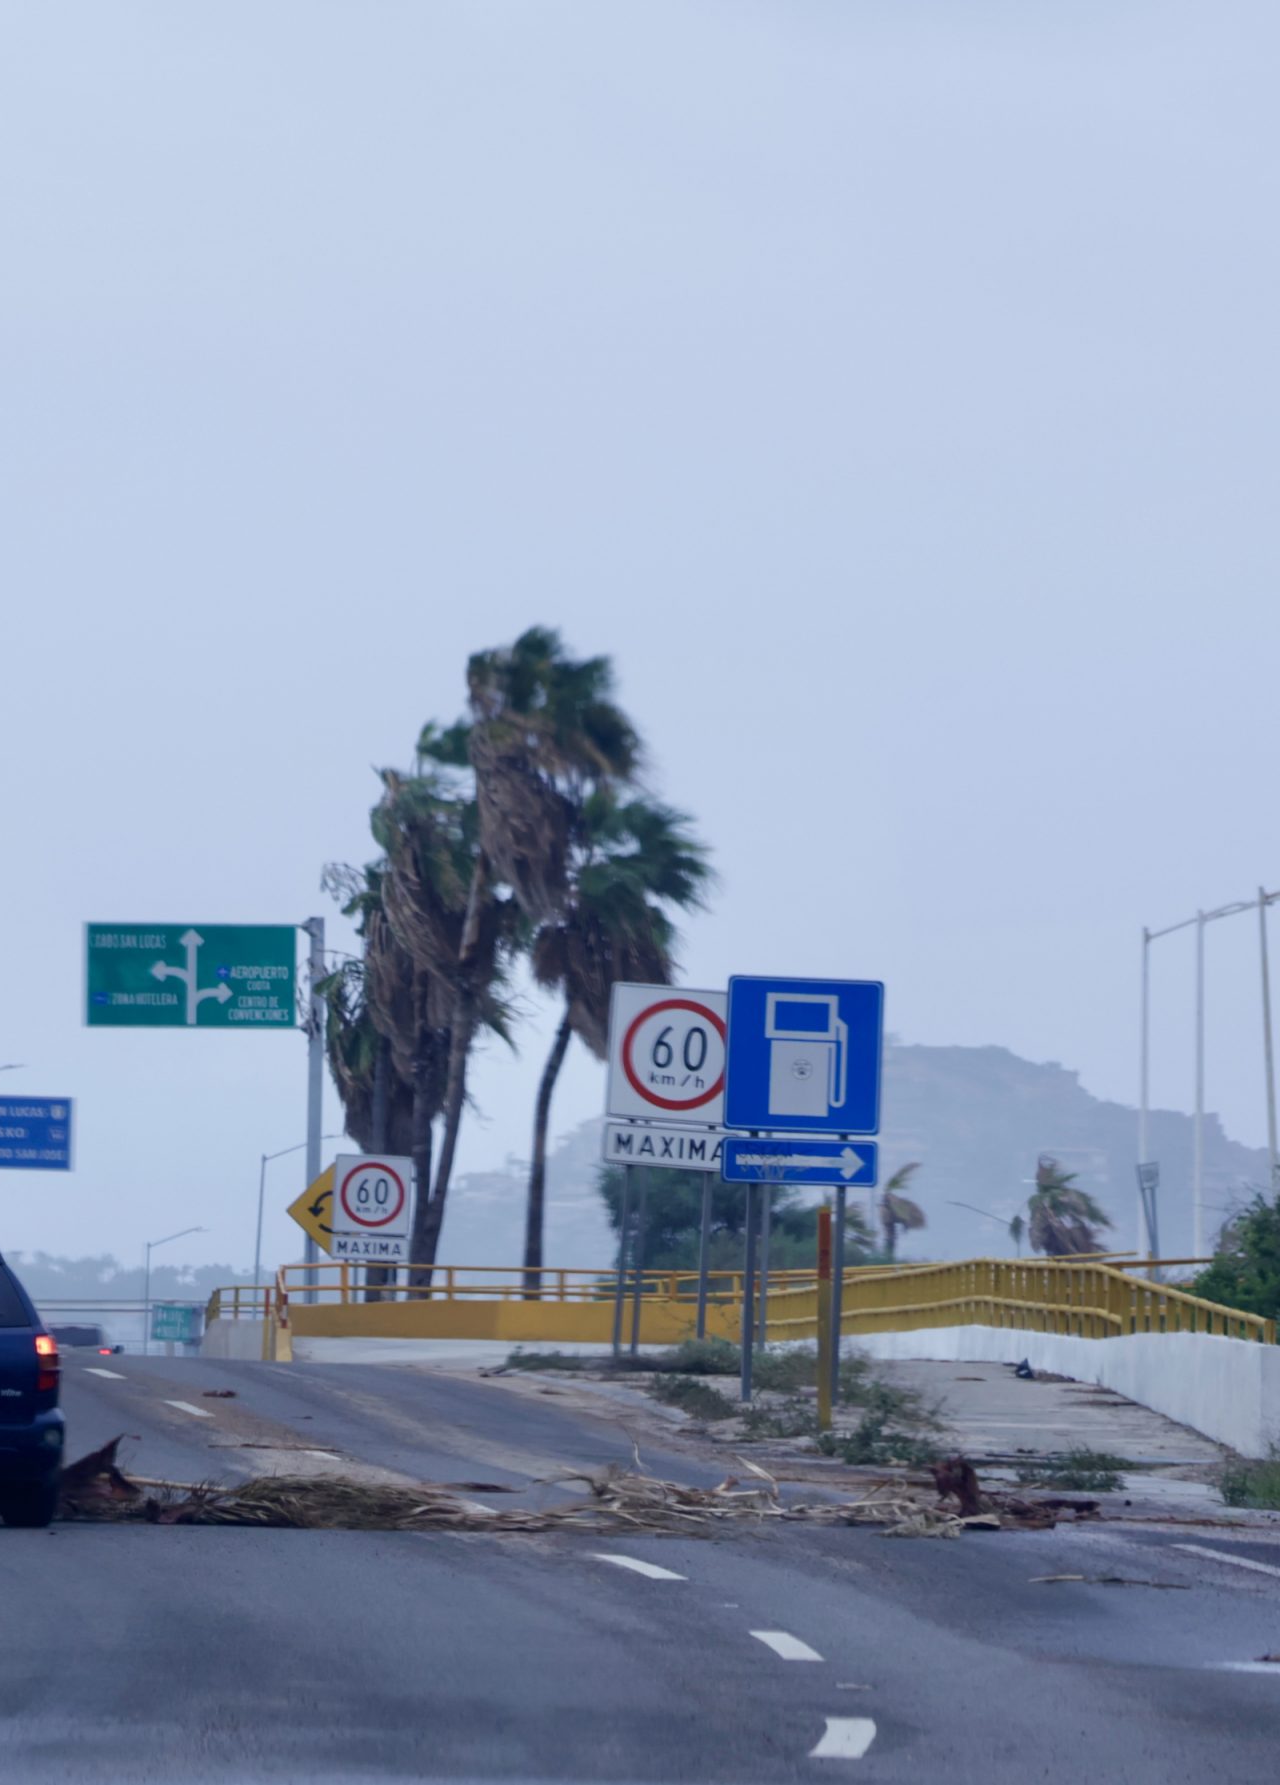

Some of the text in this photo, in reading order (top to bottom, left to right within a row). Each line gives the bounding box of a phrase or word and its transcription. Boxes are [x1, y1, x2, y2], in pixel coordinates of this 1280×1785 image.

[231, 966, 289, 980] AEROPUERTO
[238, 996, 279, 1008] CENTRO DE
[228, 1008, 289, 1021] CONVENCIONES
[652, 1025, 708, 1072] 60
[10, 1106, 44, 1118] LUCAS
[357, 1178, 389, 1205] 60
[336, 1240, 402, 1257] MAXIMA
